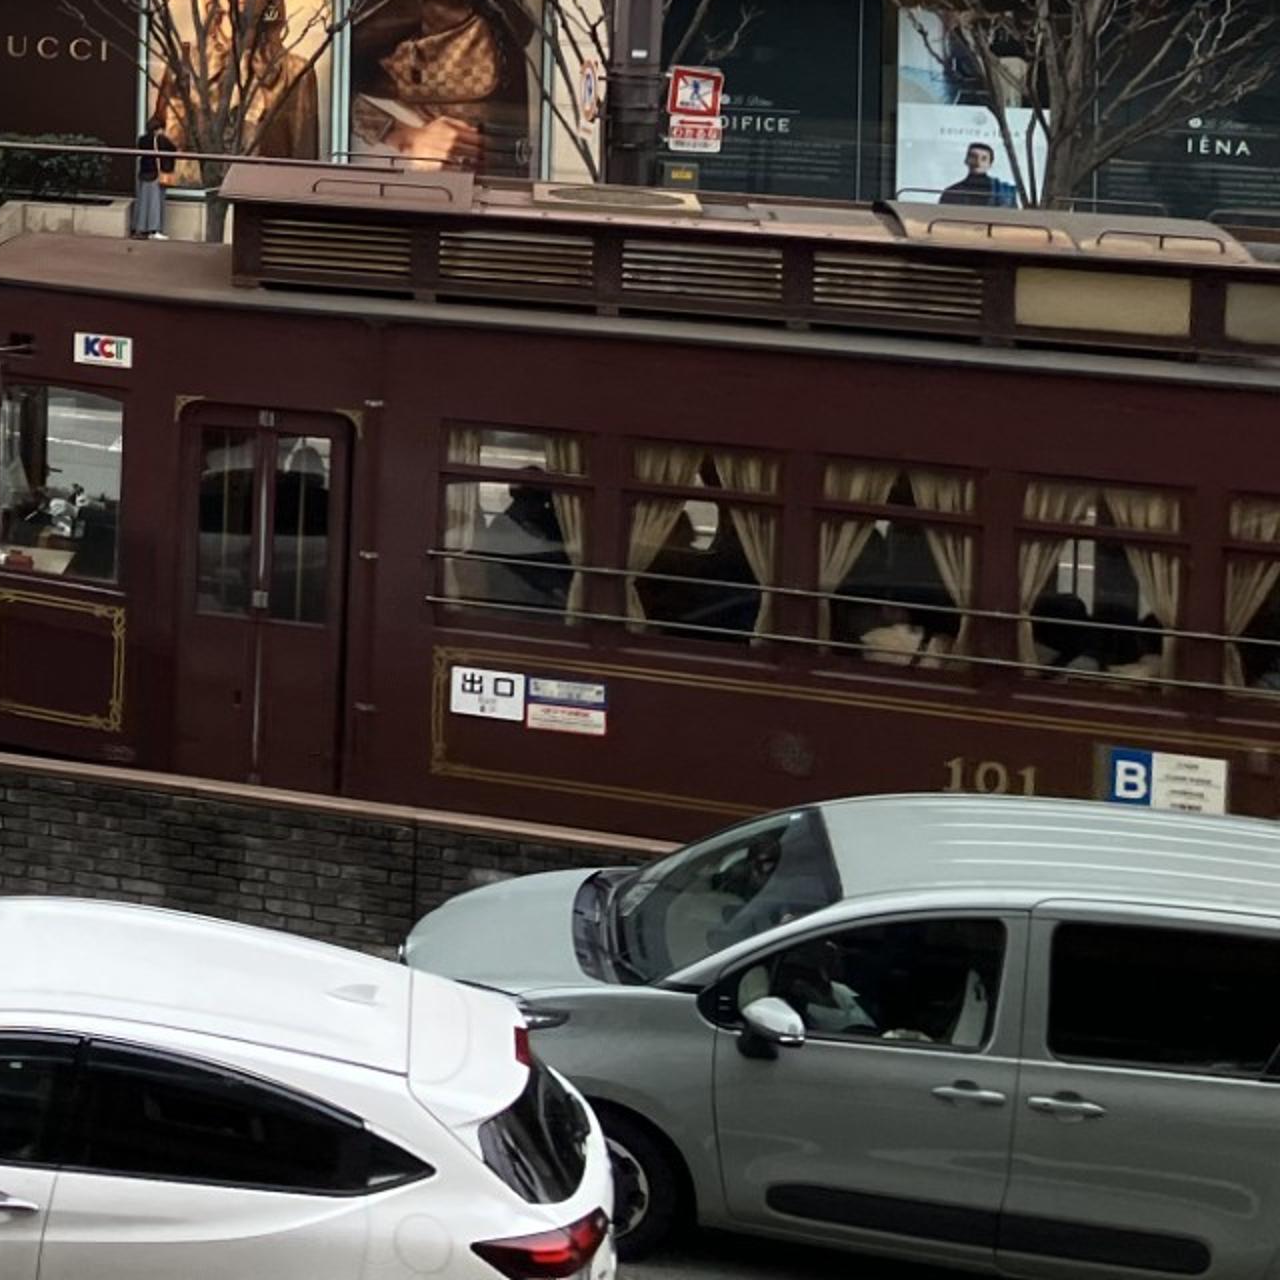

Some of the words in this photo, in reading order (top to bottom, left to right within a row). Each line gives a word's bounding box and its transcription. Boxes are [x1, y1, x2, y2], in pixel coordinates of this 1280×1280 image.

[720, 115, 790, 133] DIFICE
[83, 335, 129, 361] KCT
[461, 672, 515, 698] 出口
[943, 756, 1037, 796] 101
[1115, 759, 1148, 799] B
